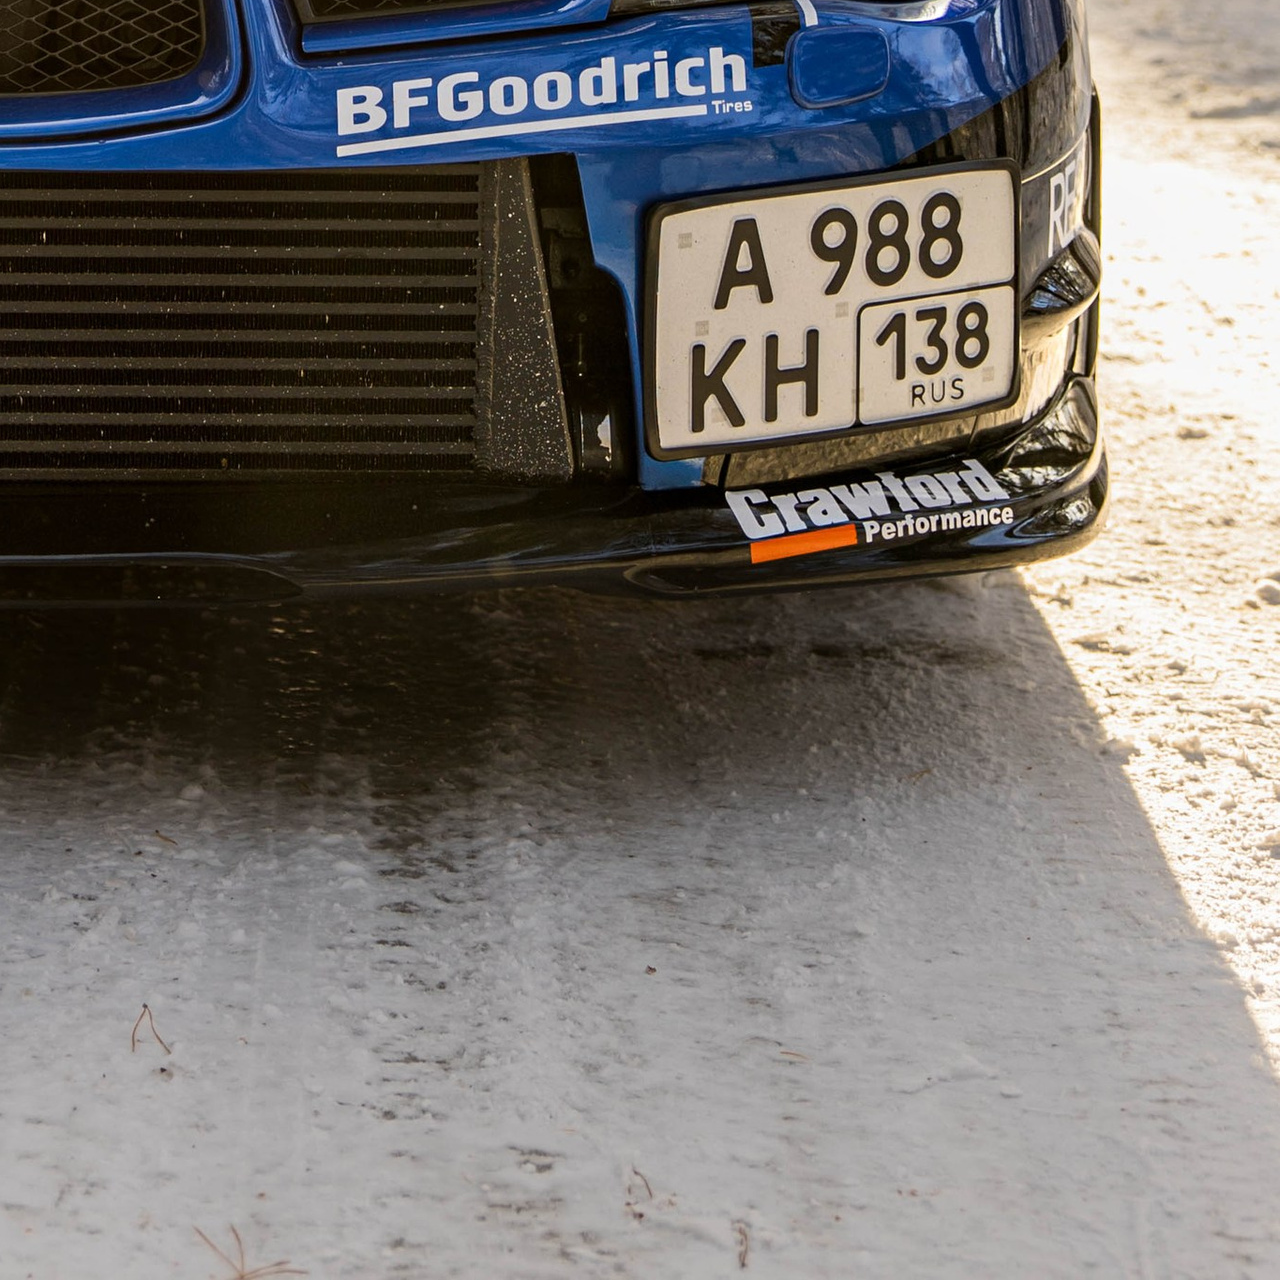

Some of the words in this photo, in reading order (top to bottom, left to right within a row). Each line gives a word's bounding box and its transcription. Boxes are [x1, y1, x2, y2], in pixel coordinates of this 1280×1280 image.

[336, 46, 748, 136] BFGoodrich
[711, 98, 753, 116] Tires
[714, 218, 774, 310] A
[810, 192, 963, 296] 988
[692, 328, 819, 433] KH
[876, 301, 990, 381] 138
[911, 378, 964, 407] RUS
[725, 459, 1010, 540] Crawford
[862, 507, 1014, 543] Performance
